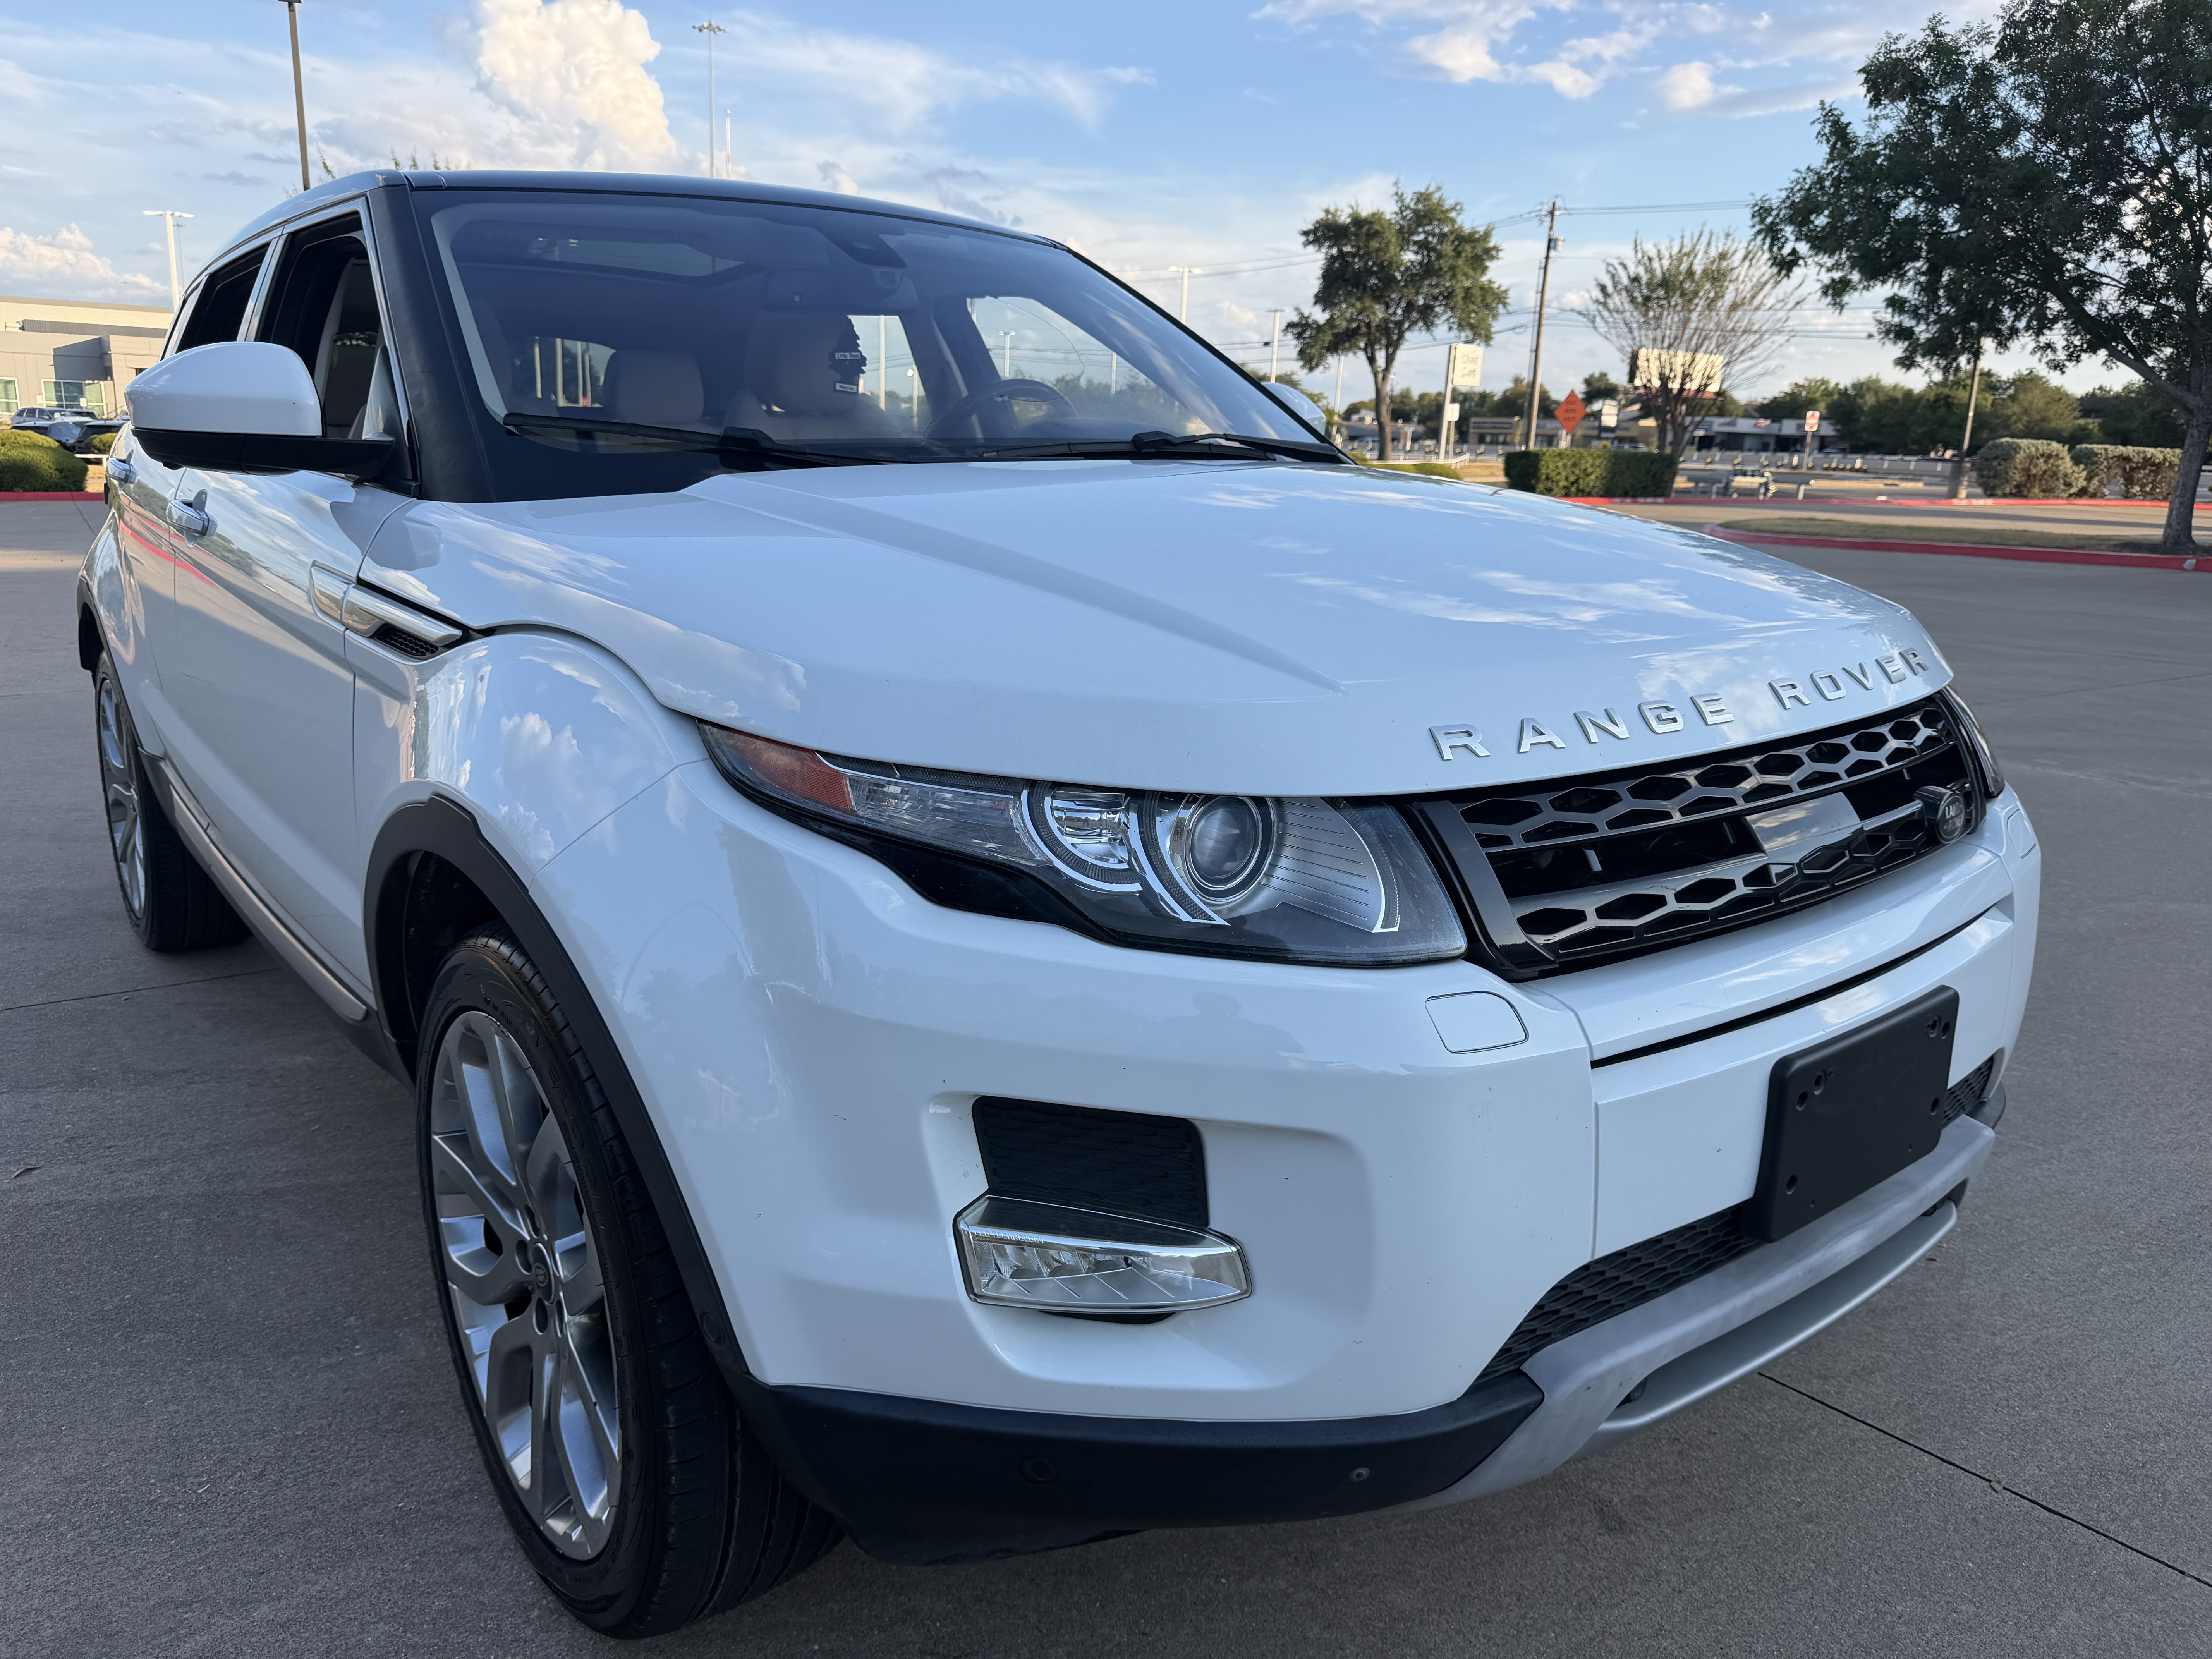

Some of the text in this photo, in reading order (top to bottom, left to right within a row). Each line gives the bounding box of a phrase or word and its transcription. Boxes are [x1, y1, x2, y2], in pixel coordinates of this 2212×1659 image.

[1429, 647, 1929, 761] RANGE ROVER
[975, 1229, 1044, 1243] LED TECHNOLOGY
